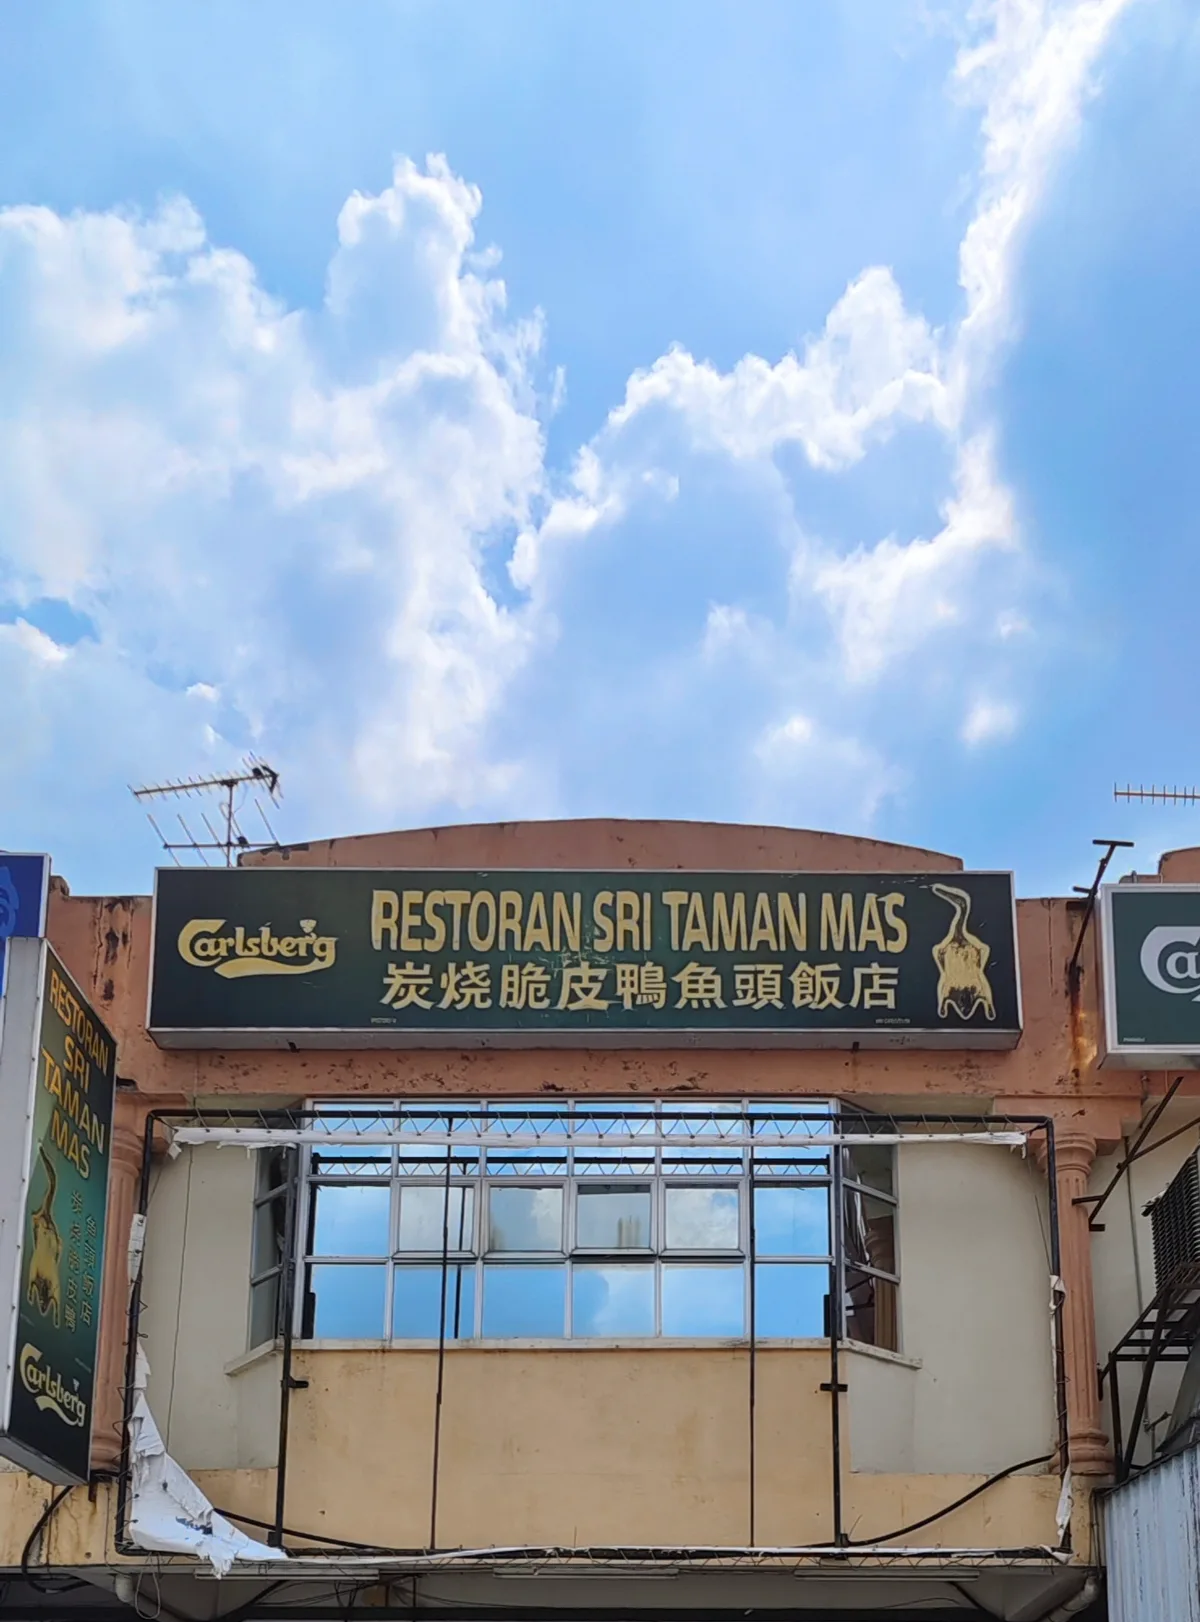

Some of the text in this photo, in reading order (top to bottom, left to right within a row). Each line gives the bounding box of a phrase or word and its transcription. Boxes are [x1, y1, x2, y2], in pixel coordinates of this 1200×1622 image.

[177, 918, 338, 979] Carlsberg
[371, 888, 909, 955] RESTORAN SRI TAMAN MAS
[380, 960, 899, 1012] 炭烧脆皮鴨魚頭飯店
[50, 968, 109, 1077] RESTORAN
[62, 1034, 91, 1095] SRI
[41, 1046, 106, 1156] TAMAN
[51, 1109, 91, 1181] MAS
[19, 1342, 87, 1428] Carlsberg
